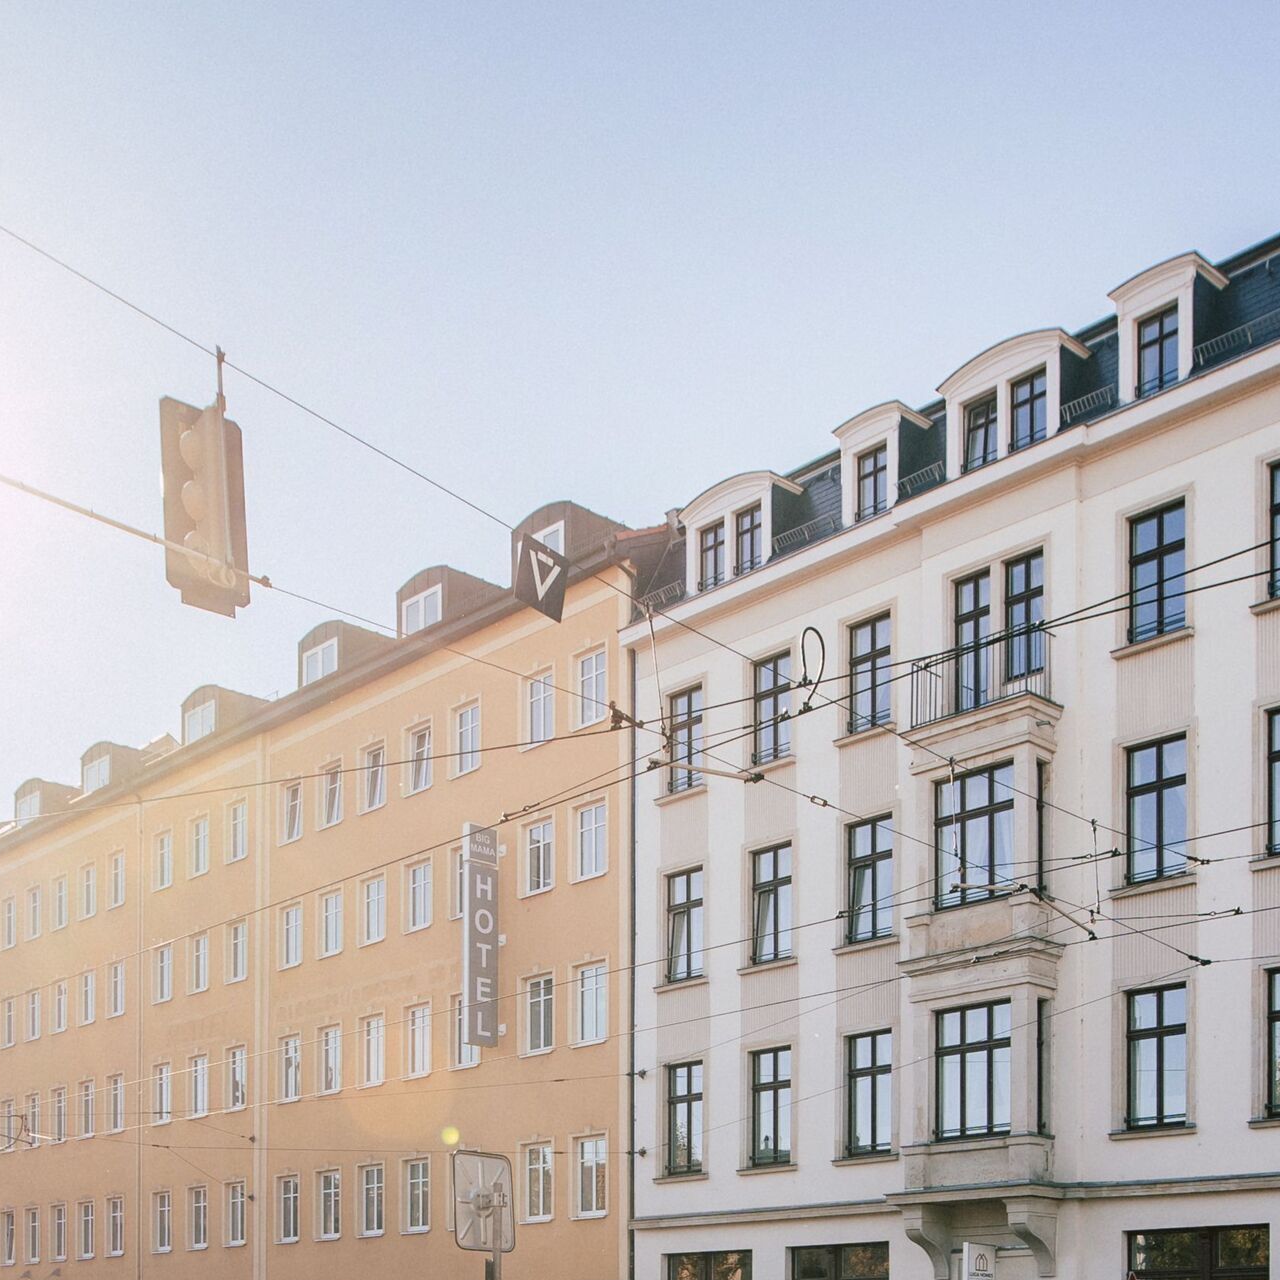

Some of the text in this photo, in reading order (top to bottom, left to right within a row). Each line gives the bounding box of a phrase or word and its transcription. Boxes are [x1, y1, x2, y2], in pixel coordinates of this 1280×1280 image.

[475, 832, 490, 844] BIG
[470, 842, 496, 857] MAMA
[474, 873, 494, 1037] HOTEL
